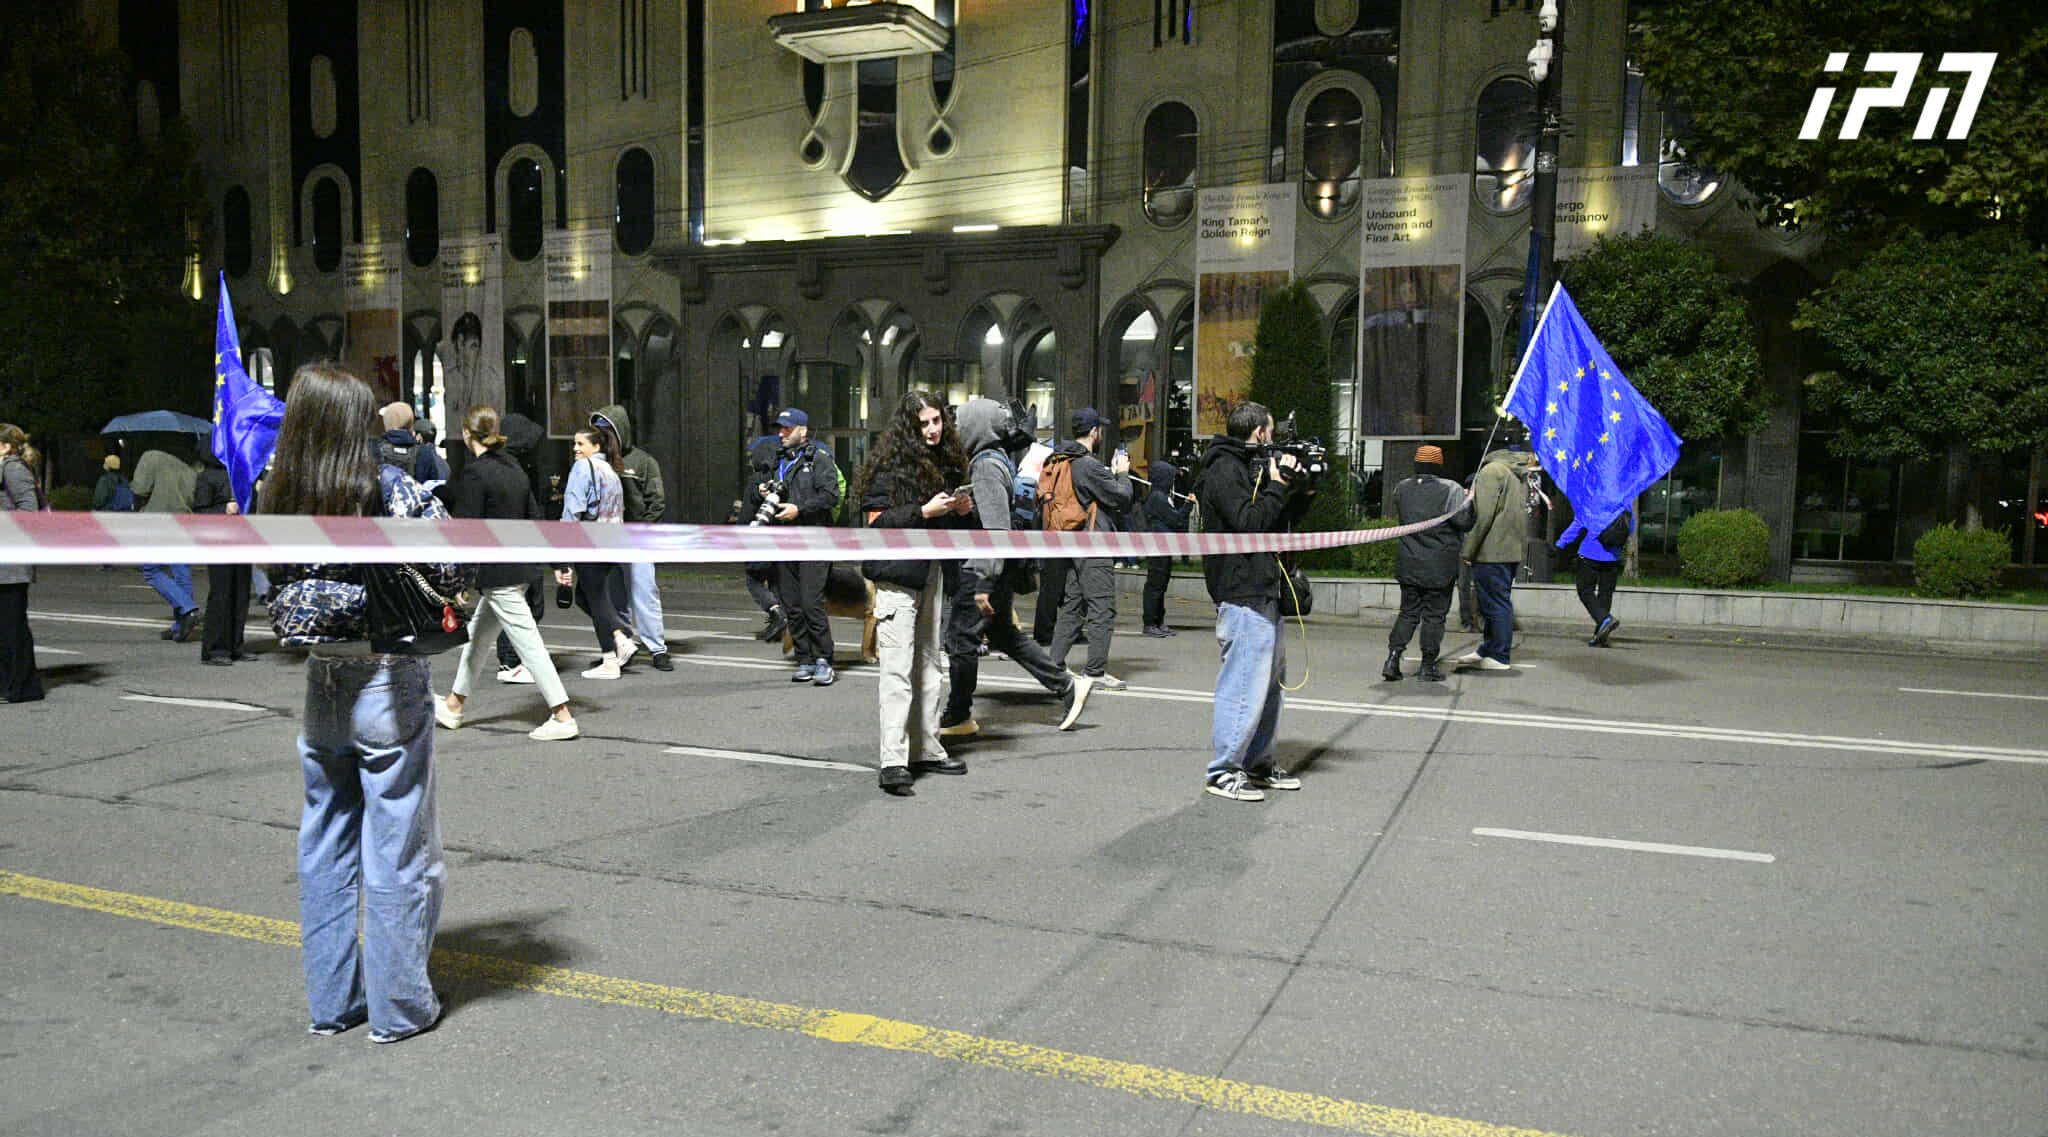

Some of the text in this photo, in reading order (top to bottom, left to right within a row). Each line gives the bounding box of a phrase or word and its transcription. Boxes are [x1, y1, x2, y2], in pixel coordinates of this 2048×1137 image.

[1556, 201, 1584, 212] ergo
[1366, 208, 1417, 220] Unbound
[1554, 213, 1609, 224] arajanov
[1201, 215, 1269, 228] King Tamar's
[1366, 218, 1433, 232] Women and
[1201, 227, 1271, 239] Golden Reign
[1366, 232, 1410, 243] Fine Art
